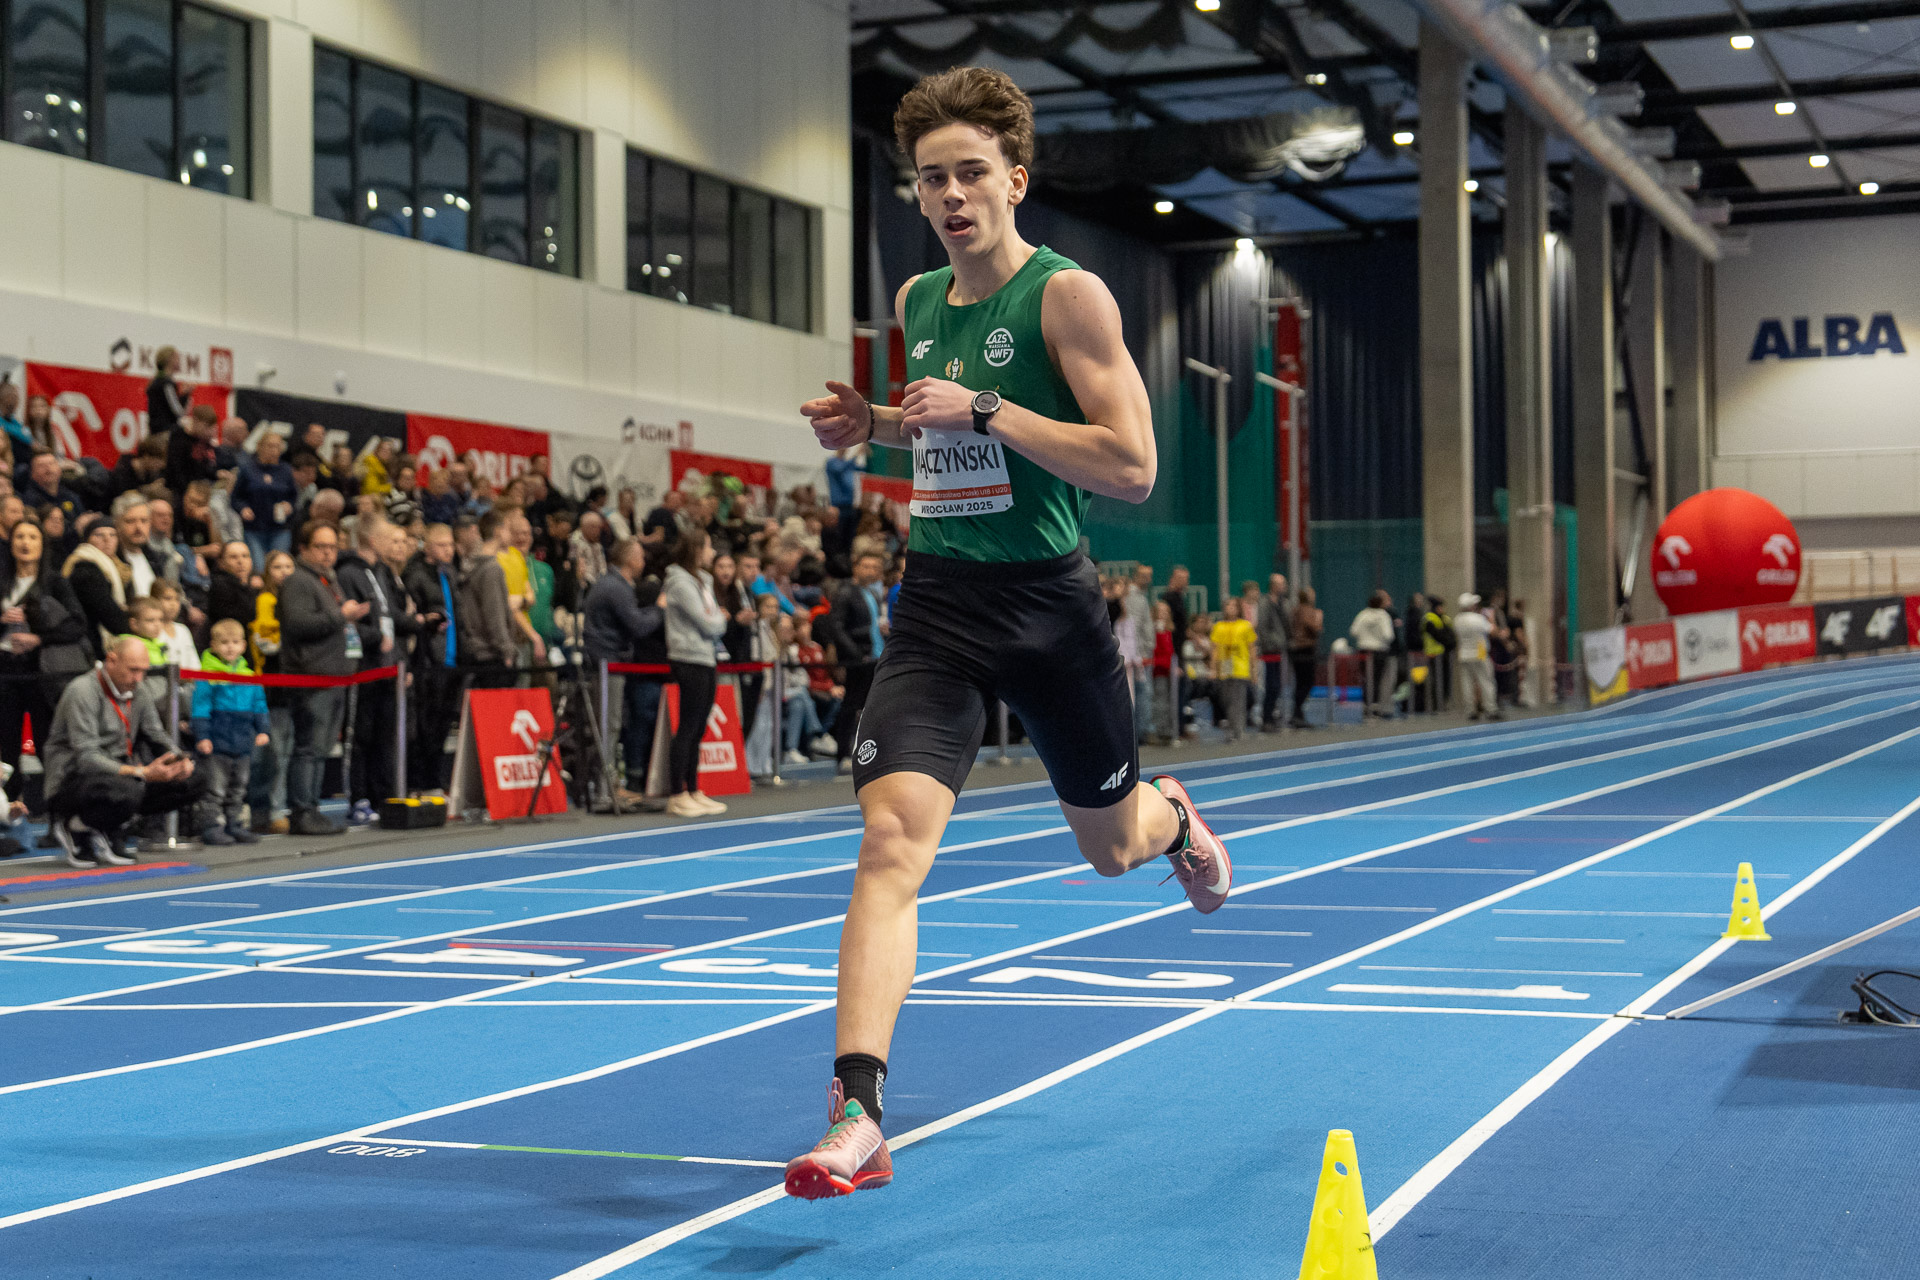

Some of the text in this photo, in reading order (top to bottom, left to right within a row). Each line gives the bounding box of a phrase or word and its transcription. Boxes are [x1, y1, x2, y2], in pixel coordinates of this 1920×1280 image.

[991, 334, 1008, 344] AZS
[1749, 311, 1907, 361] ALBA
[911, 339, 935, 360] 4F
[988, 348, 1010, 359] AWF
[914, 440, 1001, 480] MĄCZYŃSKI
[980, 488, 991, 496] U18
[995, 486, 1008, 494] U20
[921, 501, 994, 514] WROCŁAW 2025
[1821, 611, 1852, 645] 4F
[1865, 605, 1901, 640] 4F
[1100, 761, 1129, 790] 4F
[968, 966, 1235, 989] 2
[1327, 983, 1591, 1000] 1
